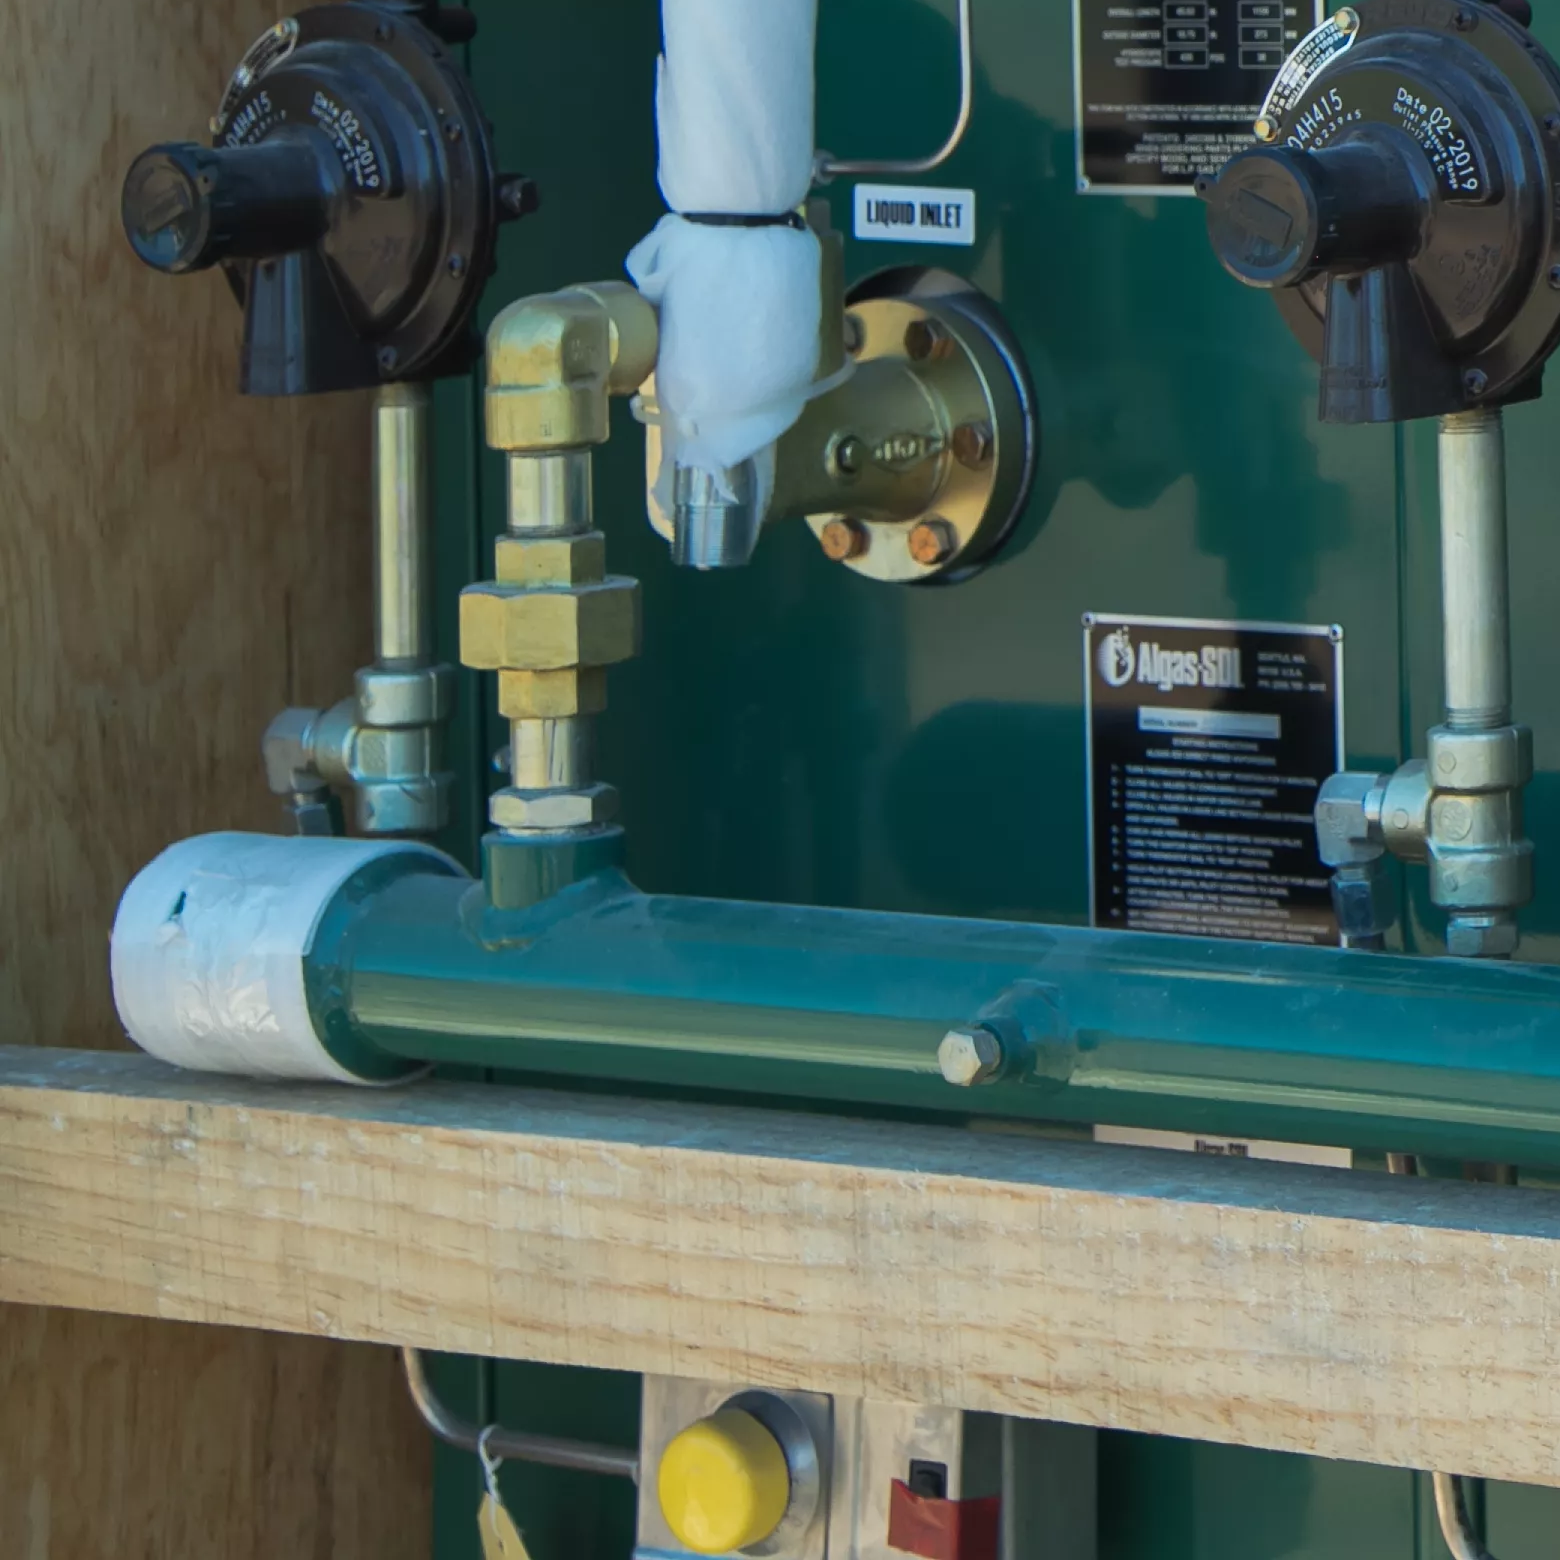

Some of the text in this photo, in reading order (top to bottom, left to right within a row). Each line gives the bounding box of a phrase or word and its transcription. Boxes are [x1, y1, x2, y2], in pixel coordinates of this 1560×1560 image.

[1397, 88, 1477, 190] Date 02-2019
[866, 200, 962, 228] LIQUID INLET
